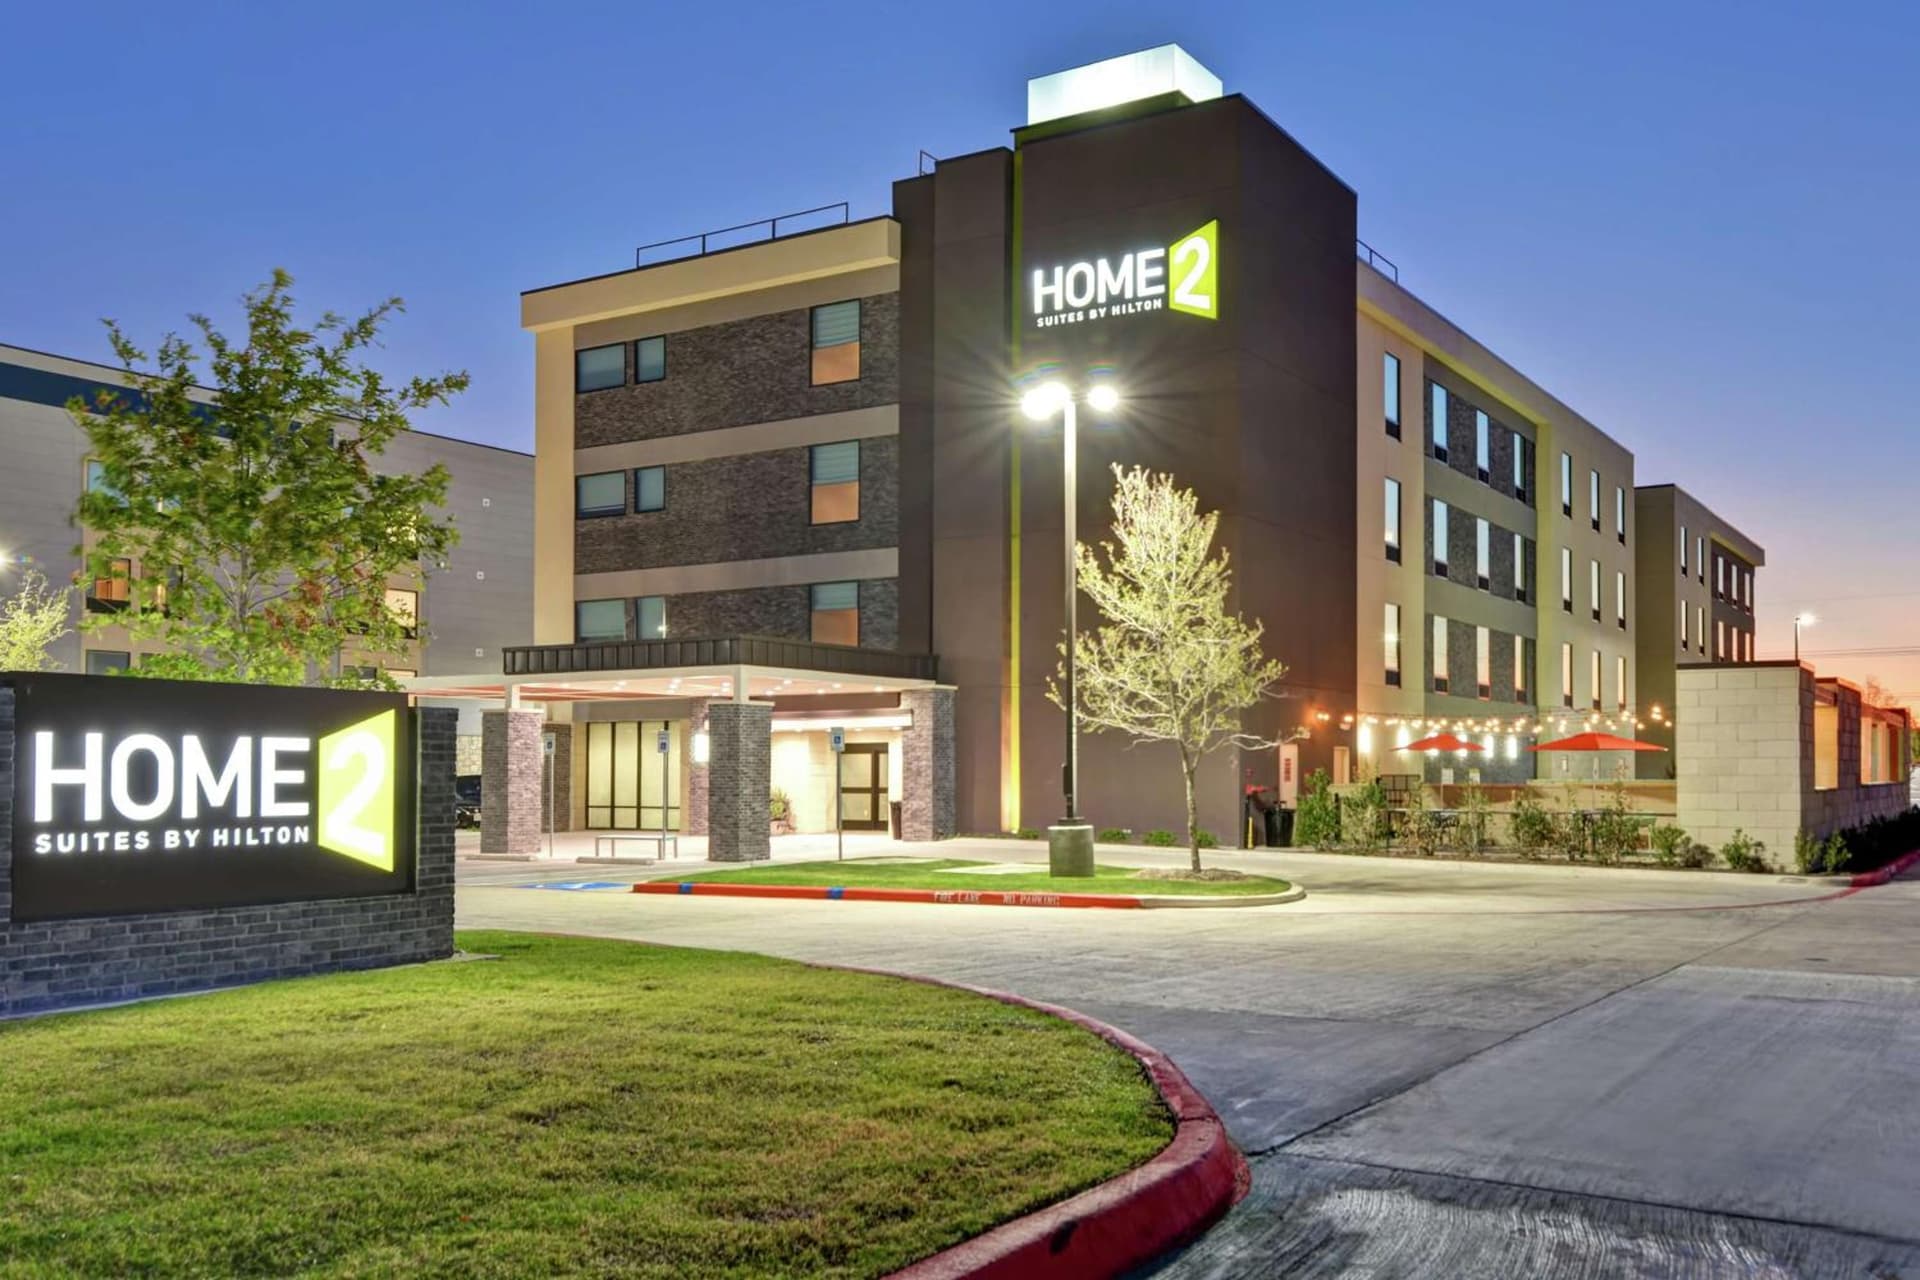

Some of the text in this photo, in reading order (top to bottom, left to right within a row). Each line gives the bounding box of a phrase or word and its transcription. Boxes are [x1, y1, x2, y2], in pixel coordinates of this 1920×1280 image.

[1033, 235, 1210, 314] HOME 2
[1037, 299, 1162, 328] SUITES BY HILTON
[34, 731, 386, 857] HOME 2
[35, 825, 309, 854] SUITES BY HILTON
